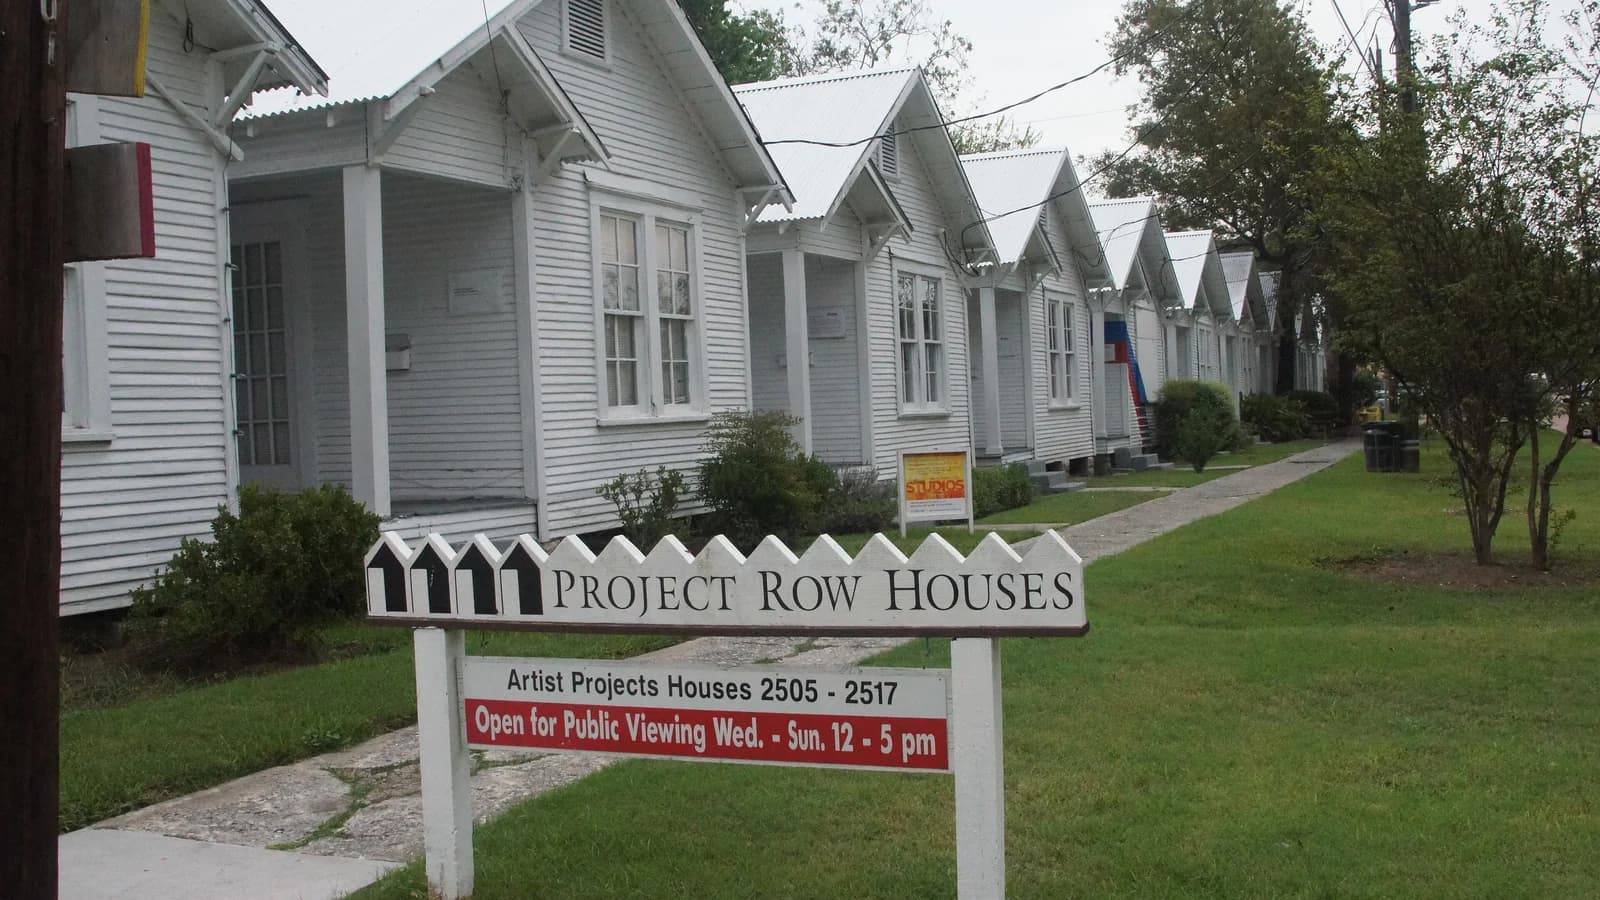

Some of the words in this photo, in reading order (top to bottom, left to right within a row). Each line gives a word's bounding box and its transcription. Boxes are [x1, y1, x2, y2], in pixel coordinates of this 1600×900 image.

[906, 480, 964, 493] STUDIOS
[552, 569, 736, 617] PROJECT
[757, 570, 863, 611] ROW
[883, 569, 1074, 611] HOUSES
[507, 669, 564, 693] Artist
[571, 671, 659, 700] Projects
[668, 674, 751, 700] Houses
[760, 677, 818, 703] 2505
[844, 680, 898, 705] 2517
[475, 704, 524, 740] Open
[530, 706, 557, 737] for
[563, 709, 620, 741] Public
[625, 712, 707, 753] Viewing
[712, 716, 764, 749] Wed.
[771, 733, 781, 743] -
[788, 719, 825, 752] Sun.
[831, 721, 854, 752] 12
[862, 737, 872, 747] -
[880, 723, 893, 755] 5
[902, 732, 936, 763] pm
